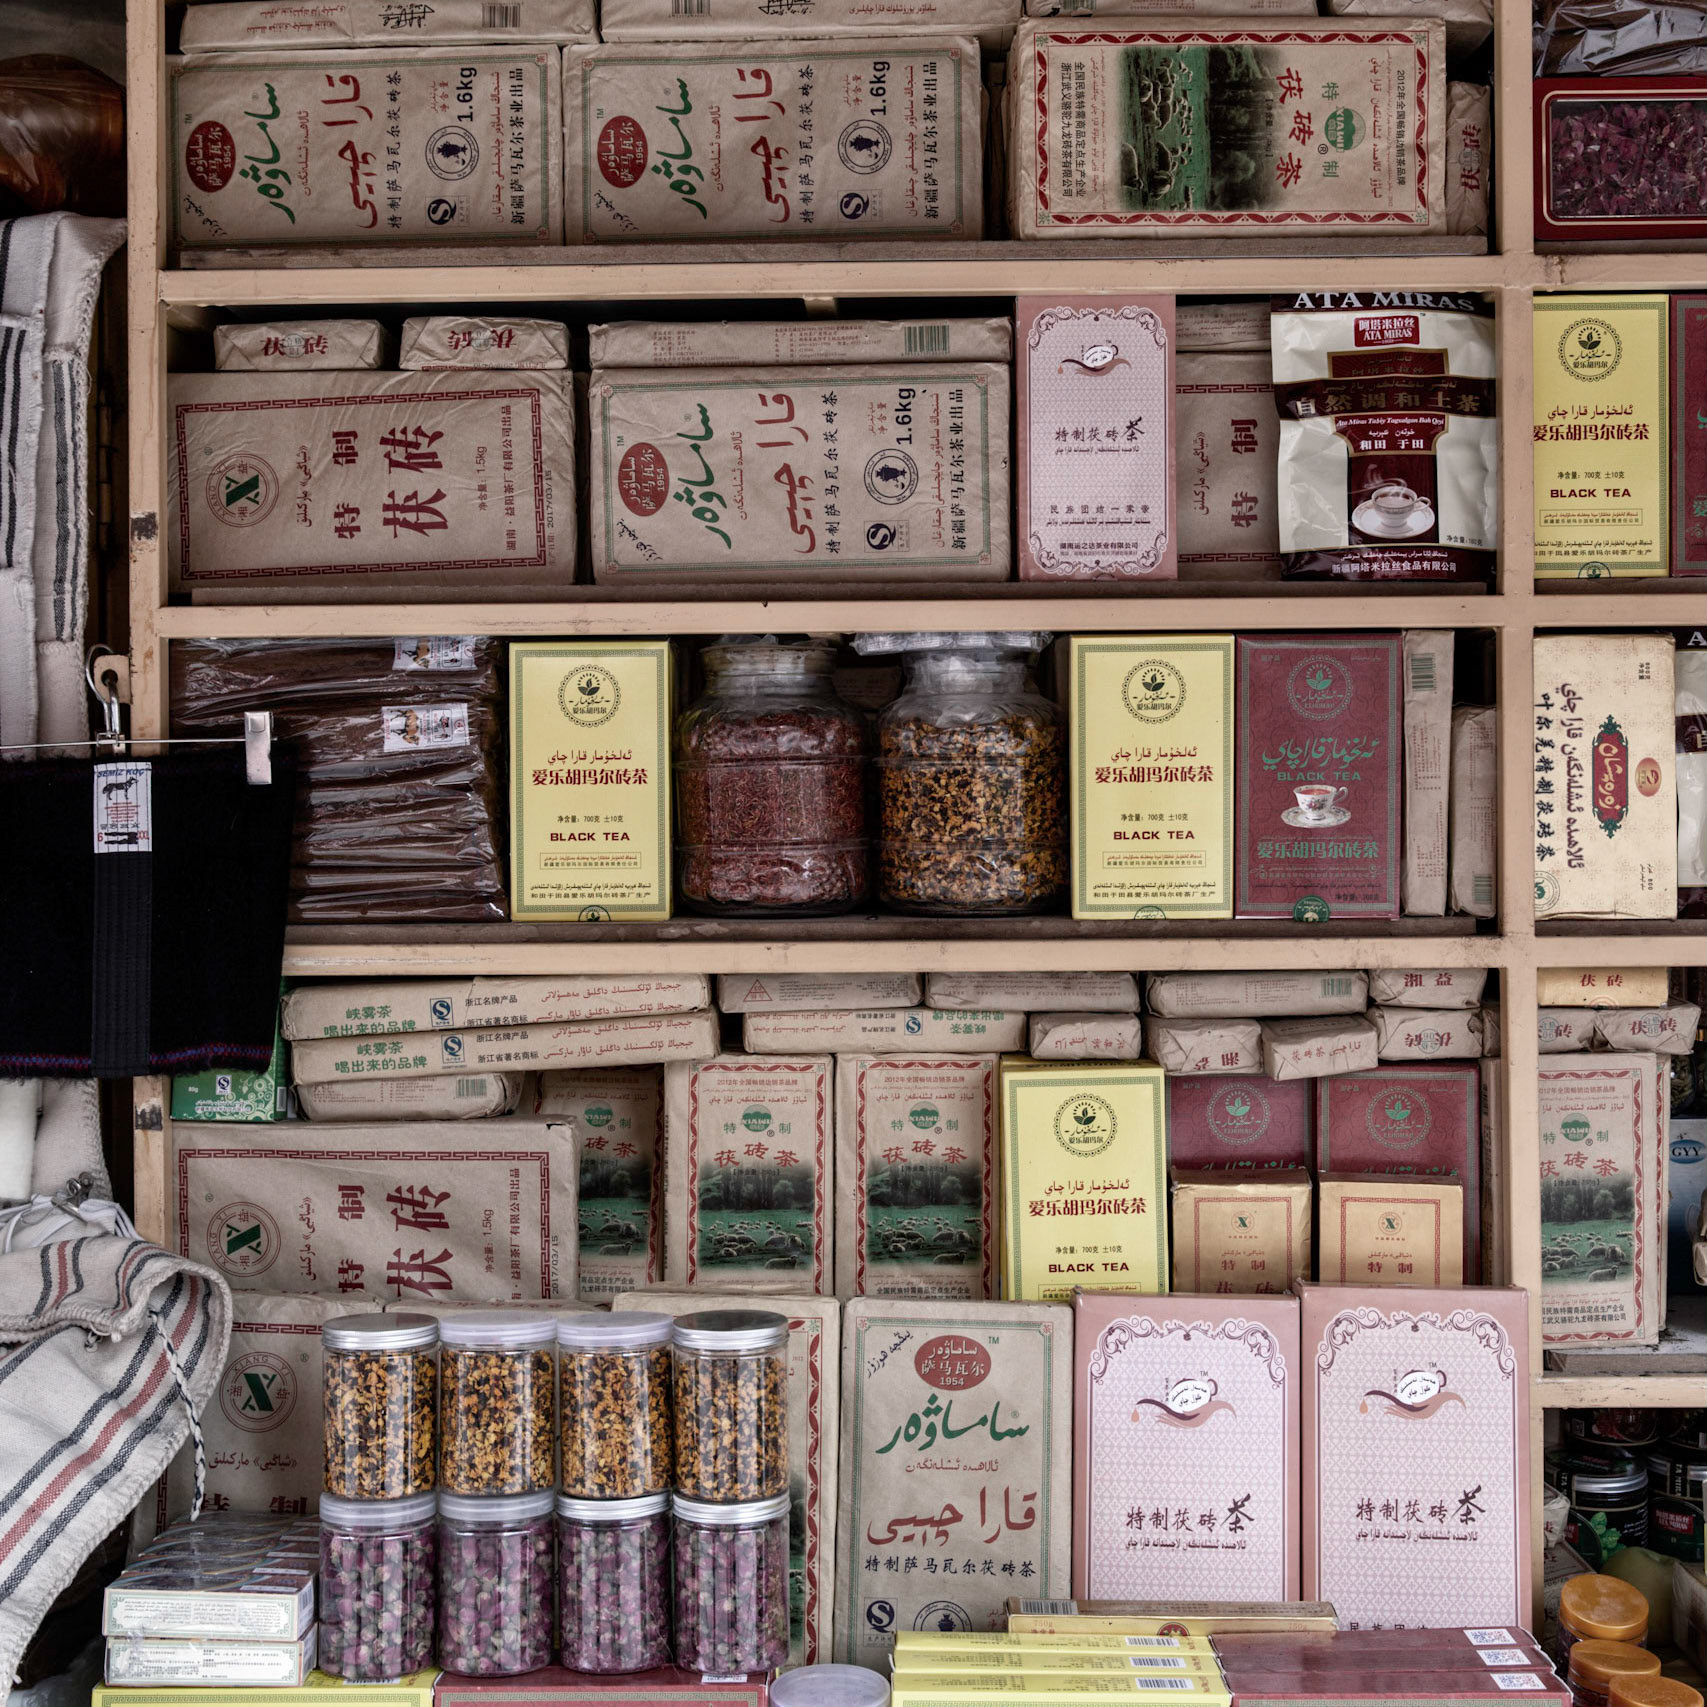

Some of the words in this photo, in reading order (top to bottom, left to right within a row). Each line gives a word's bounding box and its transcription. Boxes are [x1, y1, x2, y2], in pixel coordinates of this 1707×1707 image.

[456, 67, 476, 122] 1.6kg
[868, 61, 889, 116] 1.6kg
[1321, 83, 1339, 101] 特
[184, 114, 192, 124] TM
[596, 108, 604, 119] TM
[1060, 62, 1073, 197] 浙江武义骆驼九龙砖茶有限公司
[1073, 62, 1086, 197] 全国民族特需商品定点生产企业
[1274, 67, 1314, 189] 茯砖茶
[1395, 70, 1407, 186] 2012年全国畅销边销茶品牌
[386, 71, 401, 228] 特制萨马瓦尔茯砖茶
[508, 68, 525, 224] 新疆萨马瓦尔茶业出品
[799, 64, 814, 223] 特制萨马瓦尔茯砖茶
[923, 62, 939, 219] 新疆萨马瓦尔茶业出品
[208, 127, 222, 186] 萨马瓦尔
[223, 145, 232, 169] 1954
[620, 121, 635, 182] 萨马瓦尔
[635, 140, 644, 164] 1954
[1322, 161, 1339, 178] 制
[1294, 292, 1361, 309] ATA
[1372, 292, 1475, 311] MIRAS
[1359, 318, 1415, 331] 阿塔米拉丝
[1363, 329, 1382, 340] ATA
[1383, 328, 1413, 339] MIRAS
[1296, 394, 1480, 416] 自然调和土茶
[877, 402, 888, 435] 净含量
[894, 387, 915, 446] 1.6kg
[1055, 417, 1145, 442] 特制茯砖茶
[1534, 424, 1649, 441] 爱乐胡玛尔砖茶
[616, 435, 625, 447] TM
[1360, 440, 1386, 450] 和田
[1397, 439, 1424, 449] 于田
[475, 446, 488, 473] 1.5kg
[641, 448, 656, 510] 萨马瓦尔
[823, 391, 840, 554] 特制萨马瓦尔茯砖茶
[950, 389, 966, 550] 新疆萨马瓦尔茶业出品
[1231, 418, 1259, 528] 特制
[332, 430, 361, 539] 特制
[380, 425, 449, 539] 茯砖
[656, 468, 665, 492] 1954
[1550, 488, 1596, 498] BLACK
[1604, 488, 1631, 497] TEA
[1332, 561, 1456, 574] 新疆阿塔米拉丝食品有限公司
[532, 768, 648, 786] 爱乐胡玛尔砖茶
[1095, 766, 1214, 783] 爱乐胡玛尔砖茶
[1278, 772, 1324, 780] BLACK
[1334, 772, 1361, 780] TEA
[98, 832, 103, 842] 6
[550, 832, 596, 841] BLACK
[603, 832, 630, 841] TEA
[1113, 831, 1160, 840] BLACK
[1167, 831, 1195, 839] TEA
[1257, 842, 1379, 859] 爱乐胡玛尔砖茶
[1579, 974, 1623, 987] 茯砖
[465, 994, 518, 1007] 浙江名牌产品
[345, 1005, 392, 1021] 峡雾茶
[323, 1019, 417, 1038] 喝出来的品牌
[476, 1031, 529, 1043] 浙江名牌产品
[950, 1023, 987, 1034] 峡雾茶
[357, 1041, 404, 1056] 峡雾茶
[478, 1050, 539, 1064] 浙江省著名商标
[334, 1055, 428, 1073] 喝出来的品牌
[619, 1118, 632, 1128] 制
[724, 1122, 736, 1134] 特
[779, 1122, 791, 1134] 制
[891, 1119, 903, 1131] 特
[947, 1119, 959, 1131] 制
[1543, 1132, 1555, 1144] 特
[1597, 1130, 1608, 1142] 制
[584, 1136, 638, 1158] 砖茶
[714, 1142, 800, 1168] 茯砖茶
[882, 1138, 968, 1165] 茯砖茶
[1671, 1146, 1700, 1157] GYY
[1540, 1151, 1619, 1178] 茯砖茶
[1029, 1198, 1146, 1216] 爱乐胡玛尔砖茶
[482, 1209, 494, 1236] 1.5kg
[338, 1184, 365, 1293] 特制
[386, 1184, 454, 1297] 茯砖
[551, 1235, 559, 1294] 2017/03/15
[1049, 1262, 1095, 1273] BLACK
[1101, 1262, 1129, 1272] TEA
[1221, 1260, 1266, 1271] 特制
[1368, 1262, 1413, 1274] 特制
[988, 1337, 1000, 1345] TM
[921, 1358, 985, 1375] 萨马瓦尔
[939, 1376, 964, 1386] 1954
[1126, 1493, 1254, 1533] 特制茯砖茶
[1356, 1485, 1485, 1524] 特制茯砖茶
[865, 1555, 1036, 1577] 特制萨马瓦尔茯砖茶
